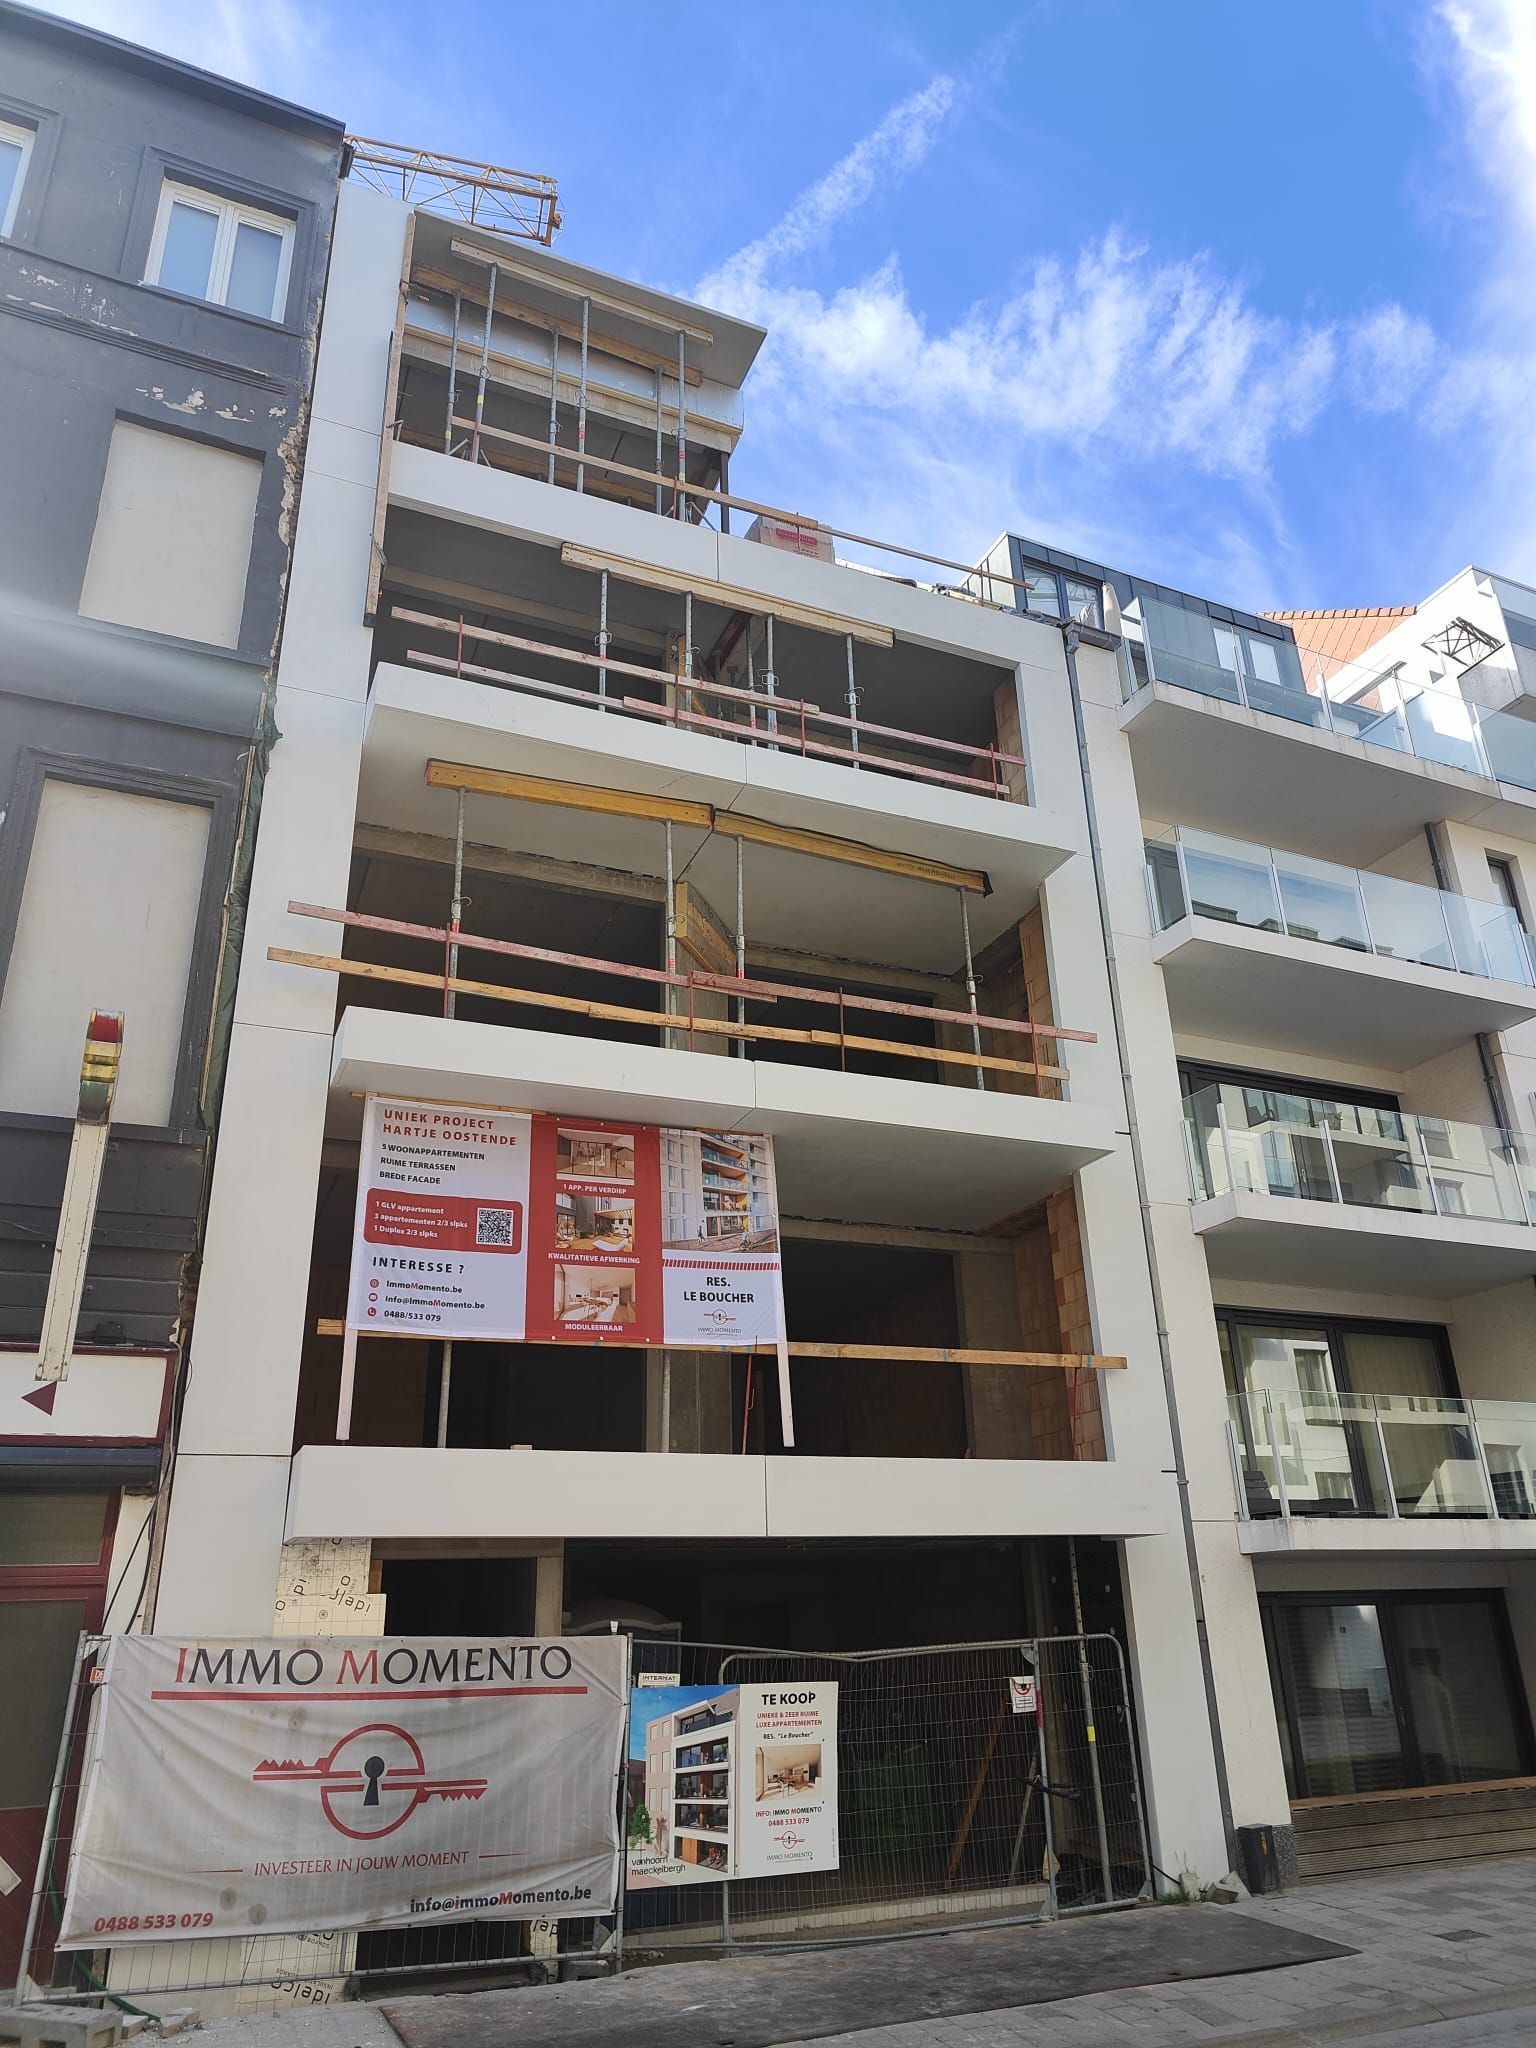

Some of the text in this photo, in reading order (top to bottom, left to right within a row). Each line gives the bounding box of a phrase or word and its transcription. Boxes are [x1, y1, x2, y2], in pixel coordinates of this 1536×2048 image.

[384, 1109, 495, 1130] UNIEK PROJECT
[383, 1124, 517, 1146] HARTJE OOSTENDE
[388, 1144, 485, 1160] WOONAPPARTEMENTEN
[380, 1156, 456, 1172] RUIME TERRASSEN
[379, 1170, 441, 1185] BREDE FACADE
[568, 1184, 584, 1192] APP.
[598, 1187, 627, 1195] VERDIEP
[381, 1201, 397, 1210] GLV
[397, 1203, 444, 1215] appartement
[380, 1213, 436, 1226] appartementen
[436, 1219, 449, 1227] 2/3
[449, 1220, 468, 1229] slpks
[379, 1225, 405, 1236] Duplex
[406, 1228, 418, 1236] 2/3
[372, 1256, 465, 1274] INTERESSE ?
[548, 1252, 641, 1264] KWALITATIEVE AFWERKING
[386, 1280, 463, 1293] ImmoMomento.be
[706, 1276, 731, 1287] RES.
[385, 1295, 485, 1309] Info@ImmoMomento.be
[683, 1290, 754, 1303] LE BOUCHER
[384, 1309, 442, 1322] 0488/533 079
[564, 1323, 623, 1332] MODULEERBAAR
[174, 1645, 573, 1686] IMMO MOMENTO
[761, 1691, 816, 1706] TE KOOP
[756, 1711, 779, 1719] UNIEKE
[755, 1719, 823, 1729] LUXE APPARTEMENTEN
[772, 1808, 790, 1816] IMMO
[790, 1806, 822, 1815] MOMENTO
[768, 1817, 810, 1827] 0488 533 079
[254, 1851, 469, 1877] INVESTEER IN JOUW MOMENT
[410, 1886, 592, 1914] info@immoMomento.be
[93, 1912, 214, 1934] 0488 533 079
